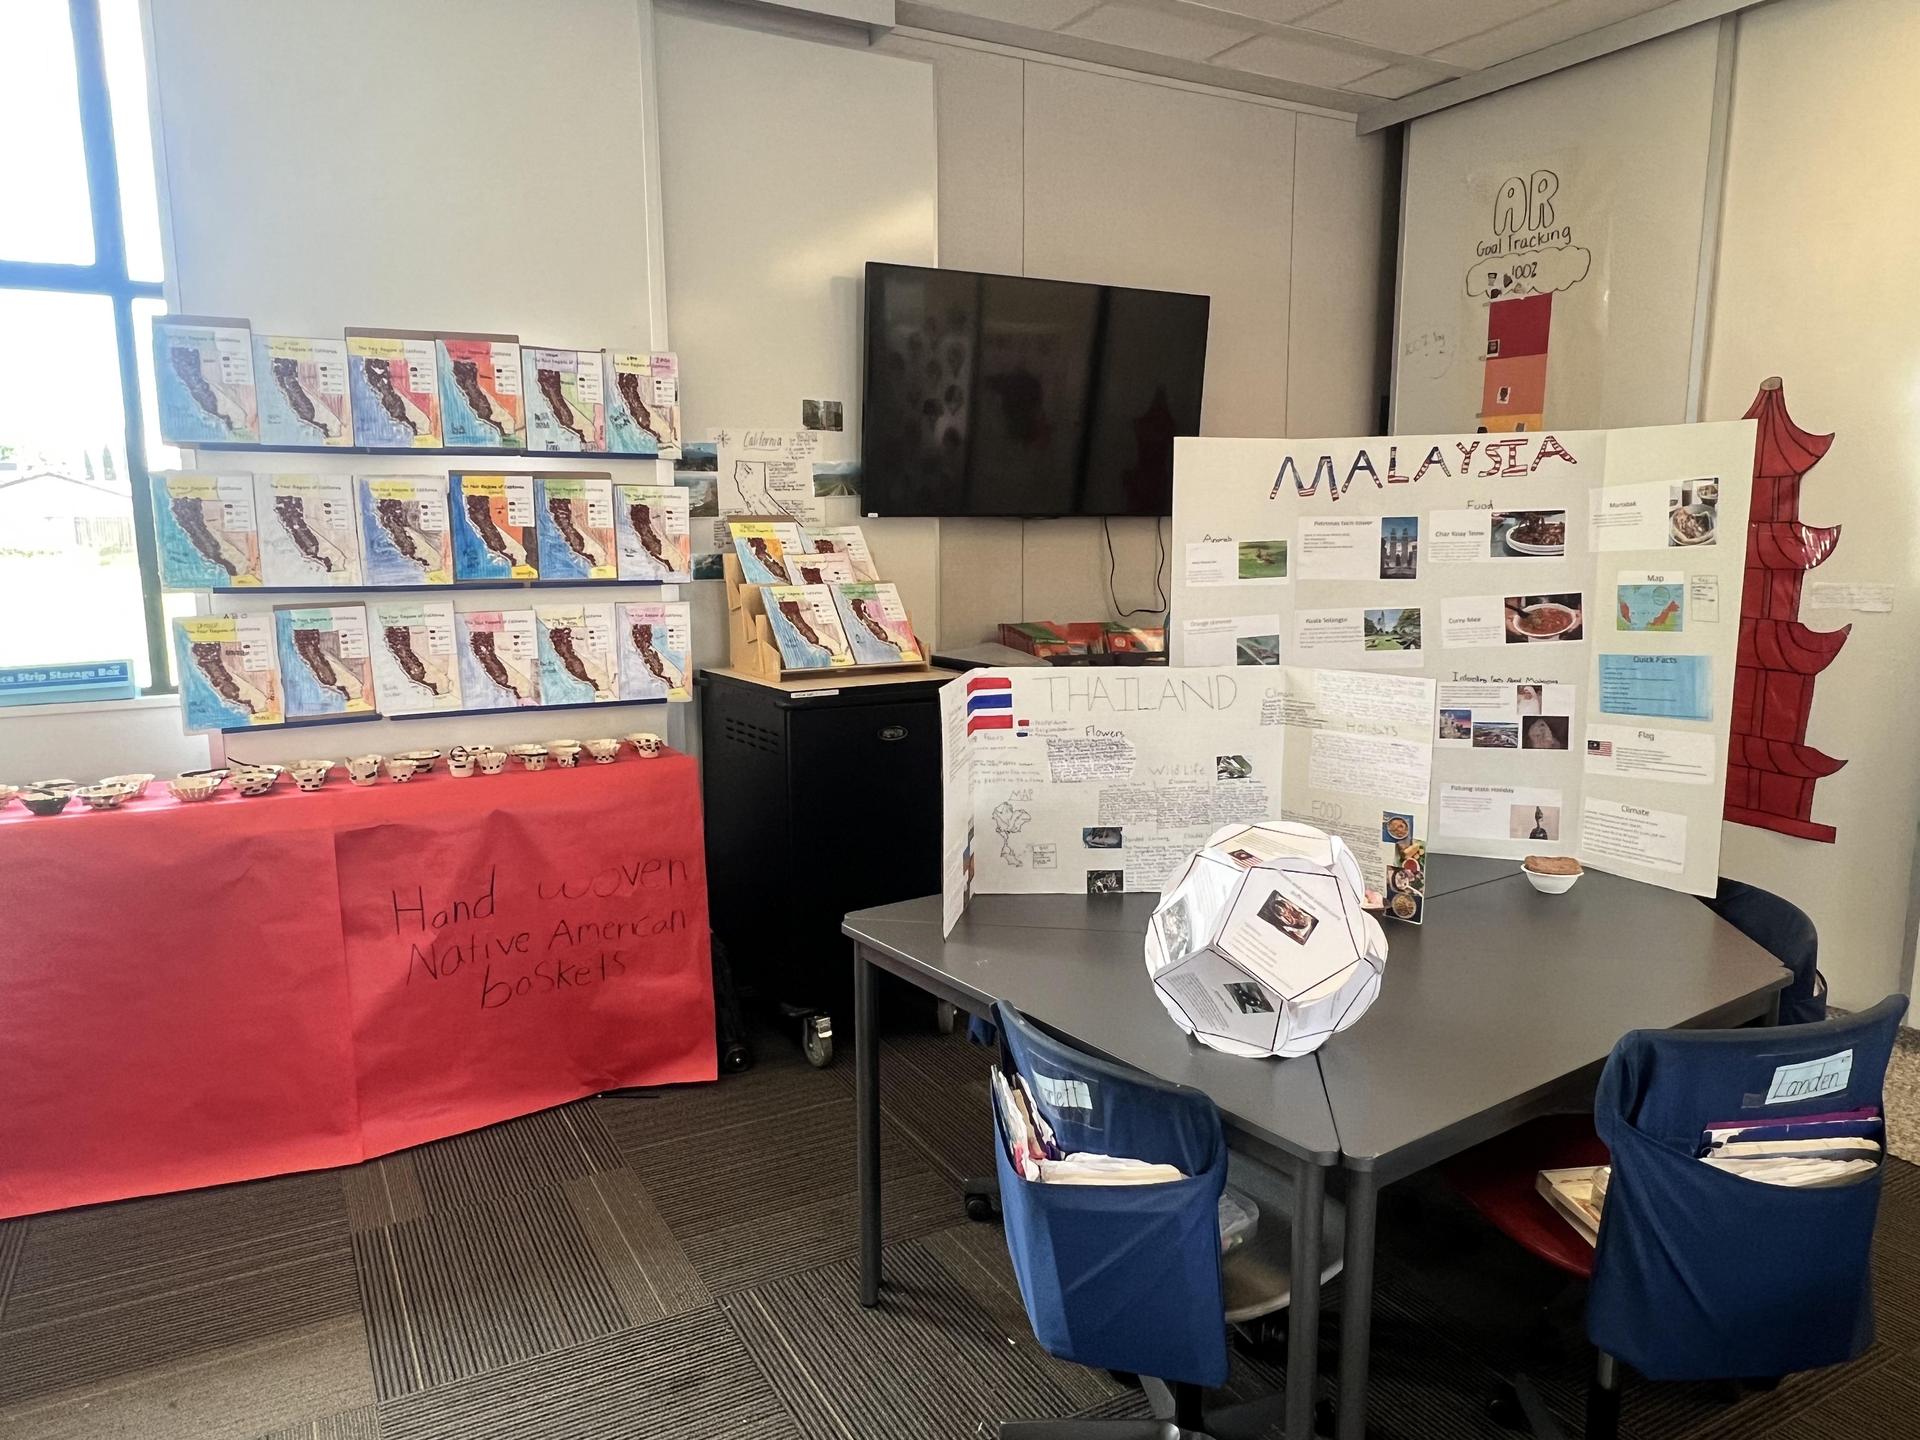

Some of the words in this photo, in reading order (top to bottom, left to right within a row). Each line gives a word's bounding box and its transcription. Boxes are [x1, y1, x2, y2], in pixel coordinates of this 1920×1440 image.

[1493, 169, 1559, 236] AR
[1508, 226, 1572, 251] Tracking
[743, 431, 783, 449] California
[1270, 435, 1577, 502] MALAYSIA
[17, 671, 47, 683] Strip
[49, 669, 96, 681] Storage
[1032, 674, 1238, 713] THAILAND
[1085, 725, 1125, 738] Flowers
[392, 864, 496, 935] Hand
[537, 858, 688, 900] woven
[406, 932, 530, 986] Native
[547, 909, 687, 950] American
[480, 950, 626, 1009] baskets
[1772, 1062, 1840, 1099] Landen
